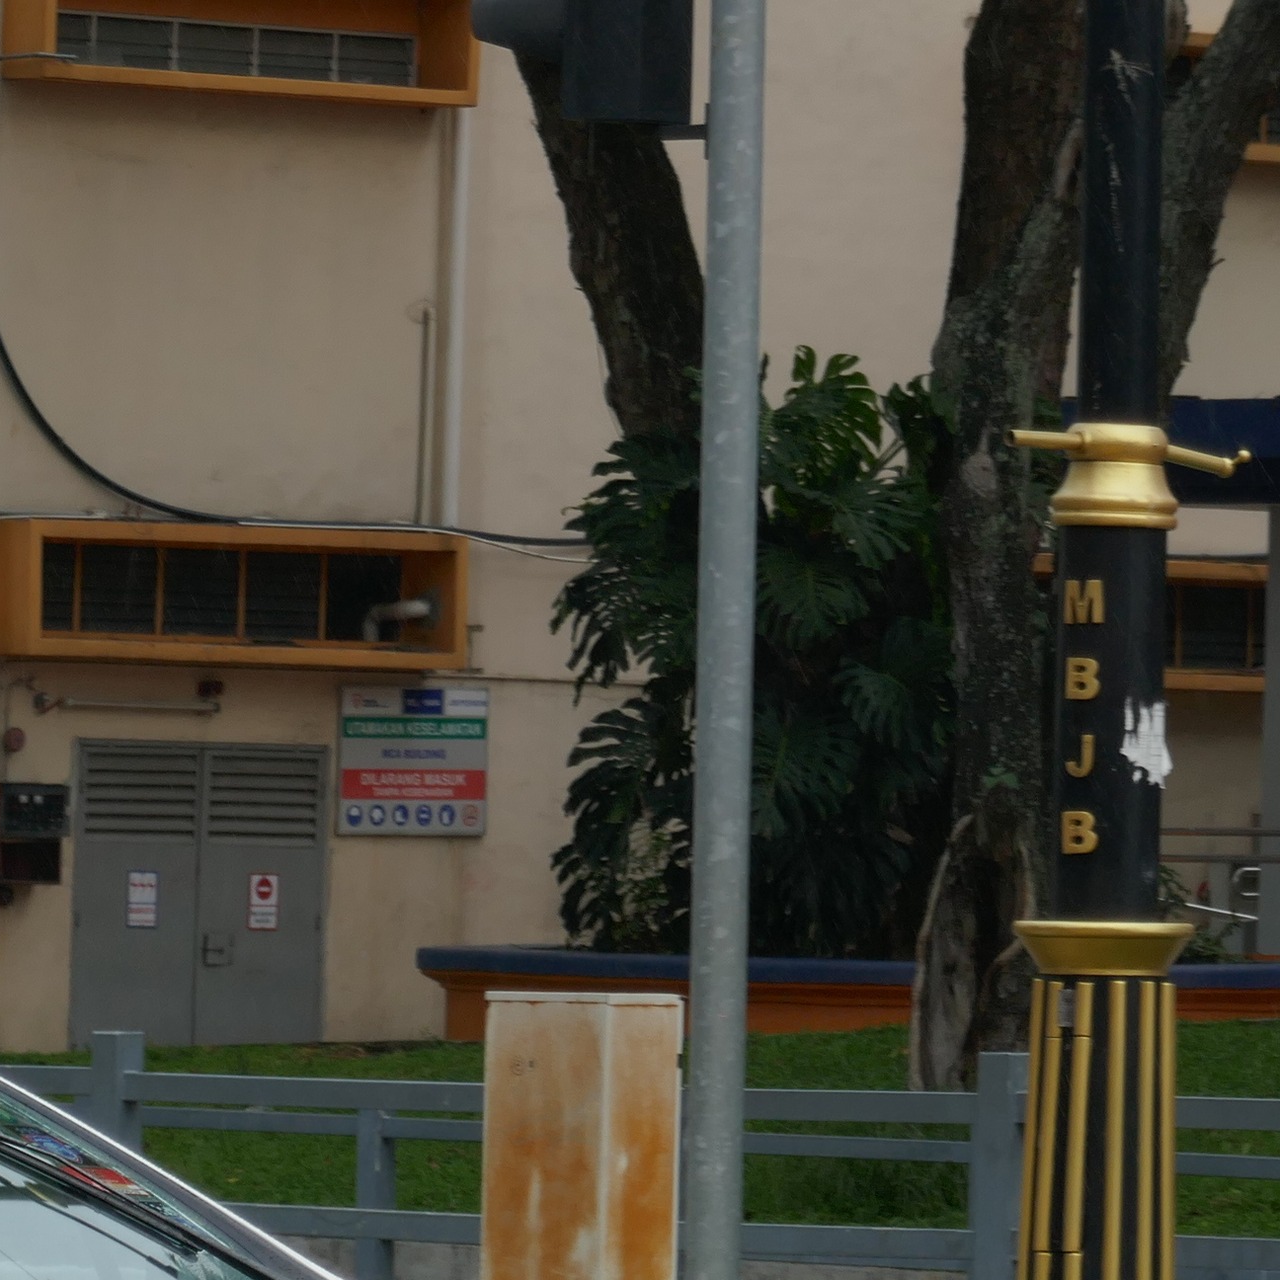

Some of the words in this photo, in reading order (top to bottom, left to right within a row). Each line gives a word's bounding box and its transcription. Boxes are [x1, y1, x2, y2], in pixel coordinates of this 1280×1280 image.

[360, 772, 422, 785] DILARANG
[423, 773, 466, 786] MASUK
[1061, 579, 1105, 855] MBJB
